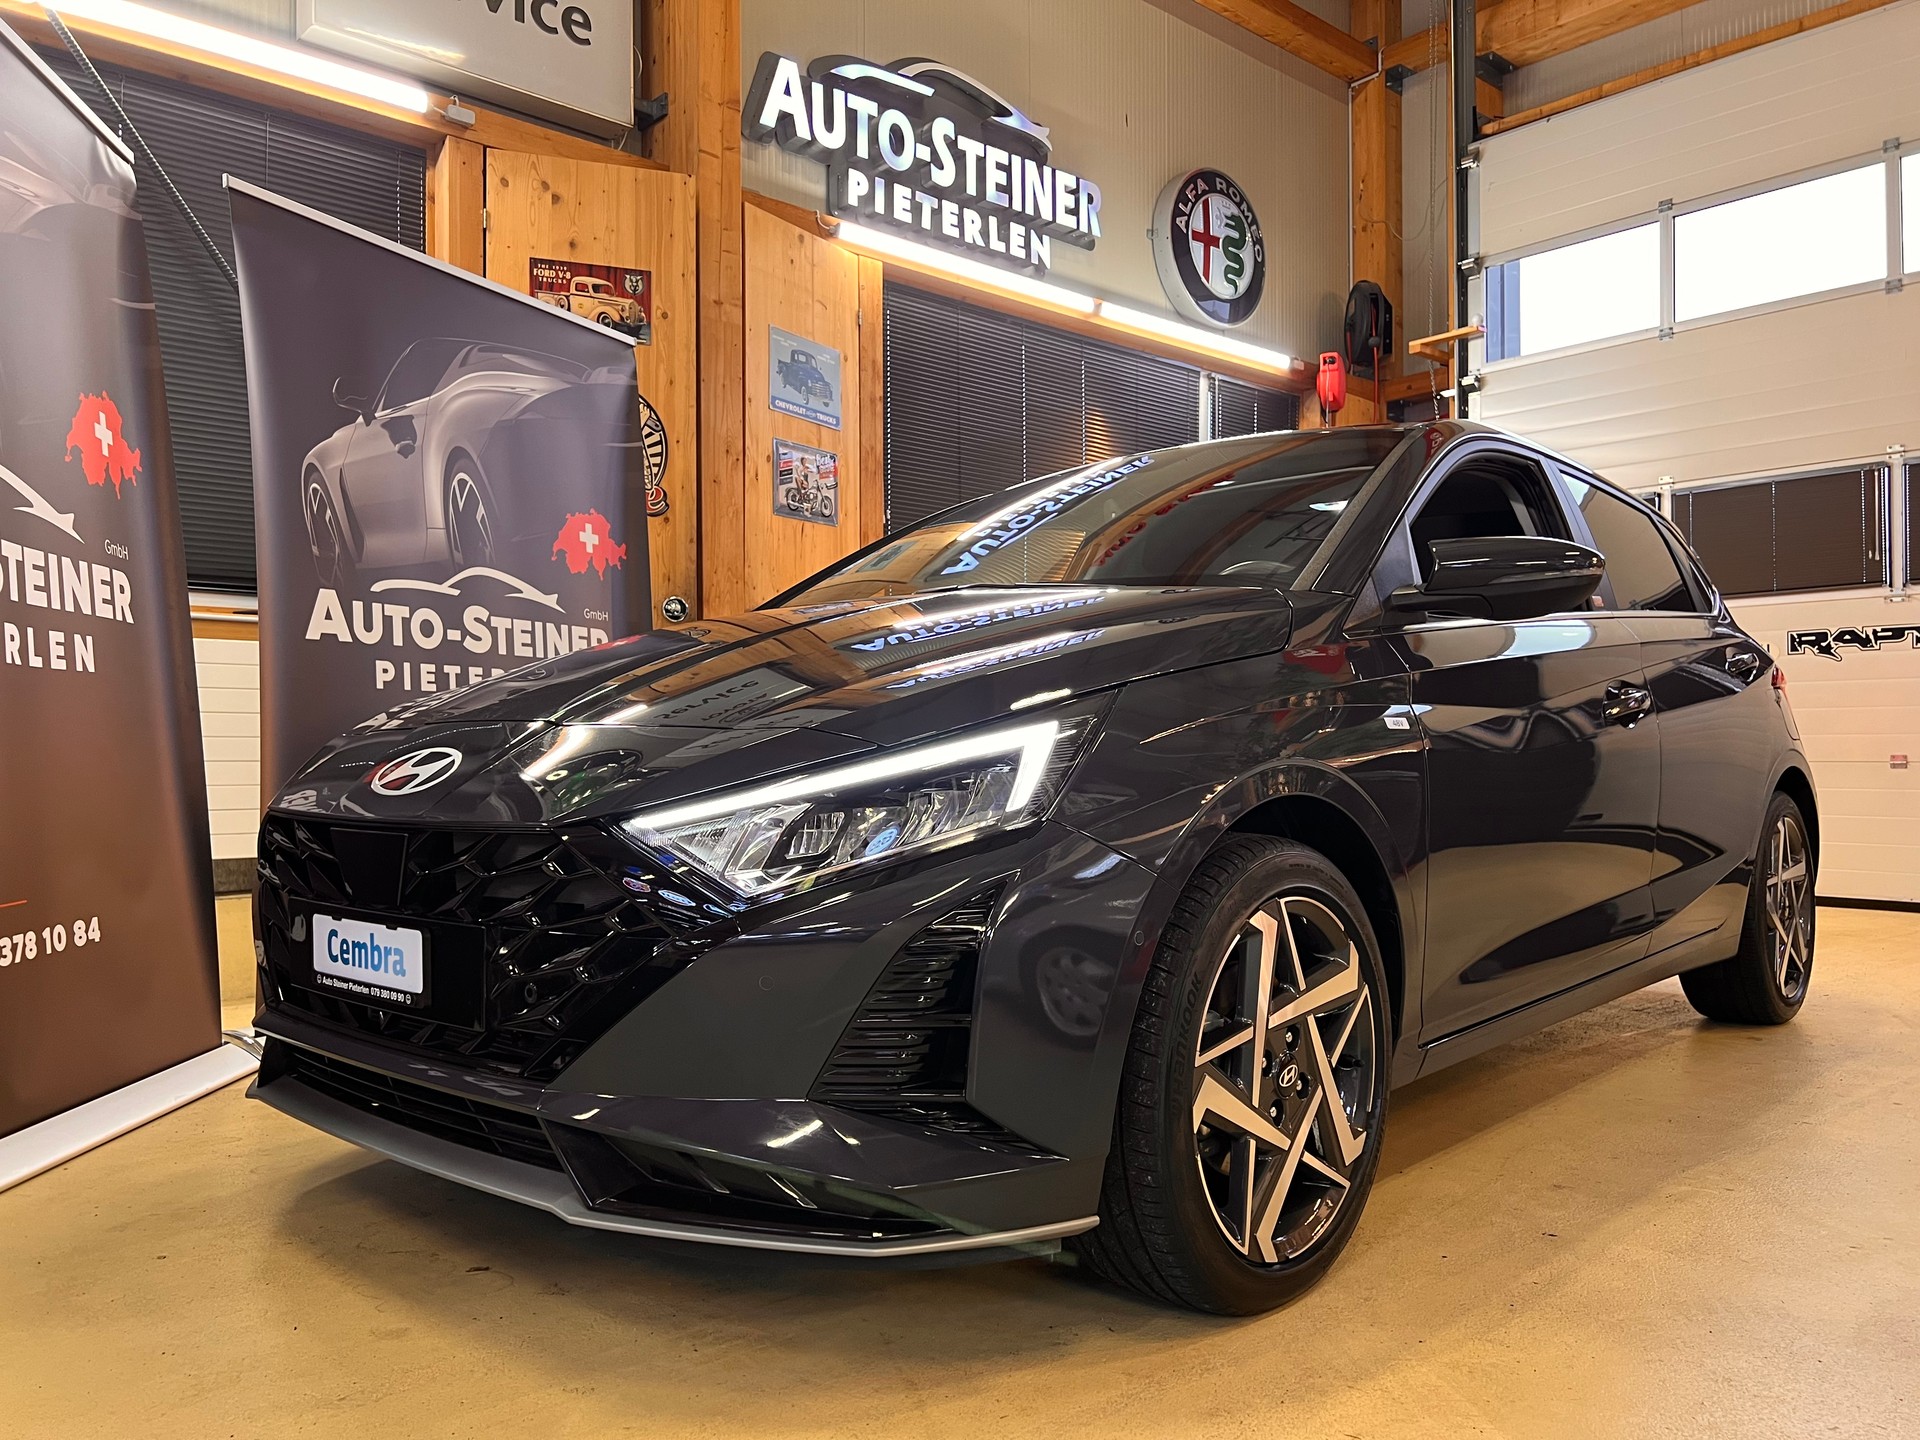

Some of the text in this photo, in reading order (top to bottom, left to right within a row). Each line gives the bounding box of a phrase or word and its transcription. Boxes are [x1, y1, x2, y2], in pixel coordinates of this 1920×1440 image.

[759, 57, 1102, 238] AUTO-STEINER
[847, 167, 1051, 269] PIETERLEN
[1176, 177, 1263, 262] ALFA ROMEO
[533, 268, 571, 280] FORD V-8
[538, 276, 567, 284] TRUCKS
[775, 399, 806, 415] CHEVROLET
[816, 412, 836, 425] TRUCKS
[104, 539, 129, 560] GmbH
[0, 539, 135, 625] TEINER
[583, 607, 609, 622] GmbH
[1788, 624, 1920, 662] RAP
[0, 916, 101, 967] 378 10 84
[327, 928, 407, 977] Cembra
[322, 976, 404, 1002] Auto Steiner Pieterlen 079 380 09 90
